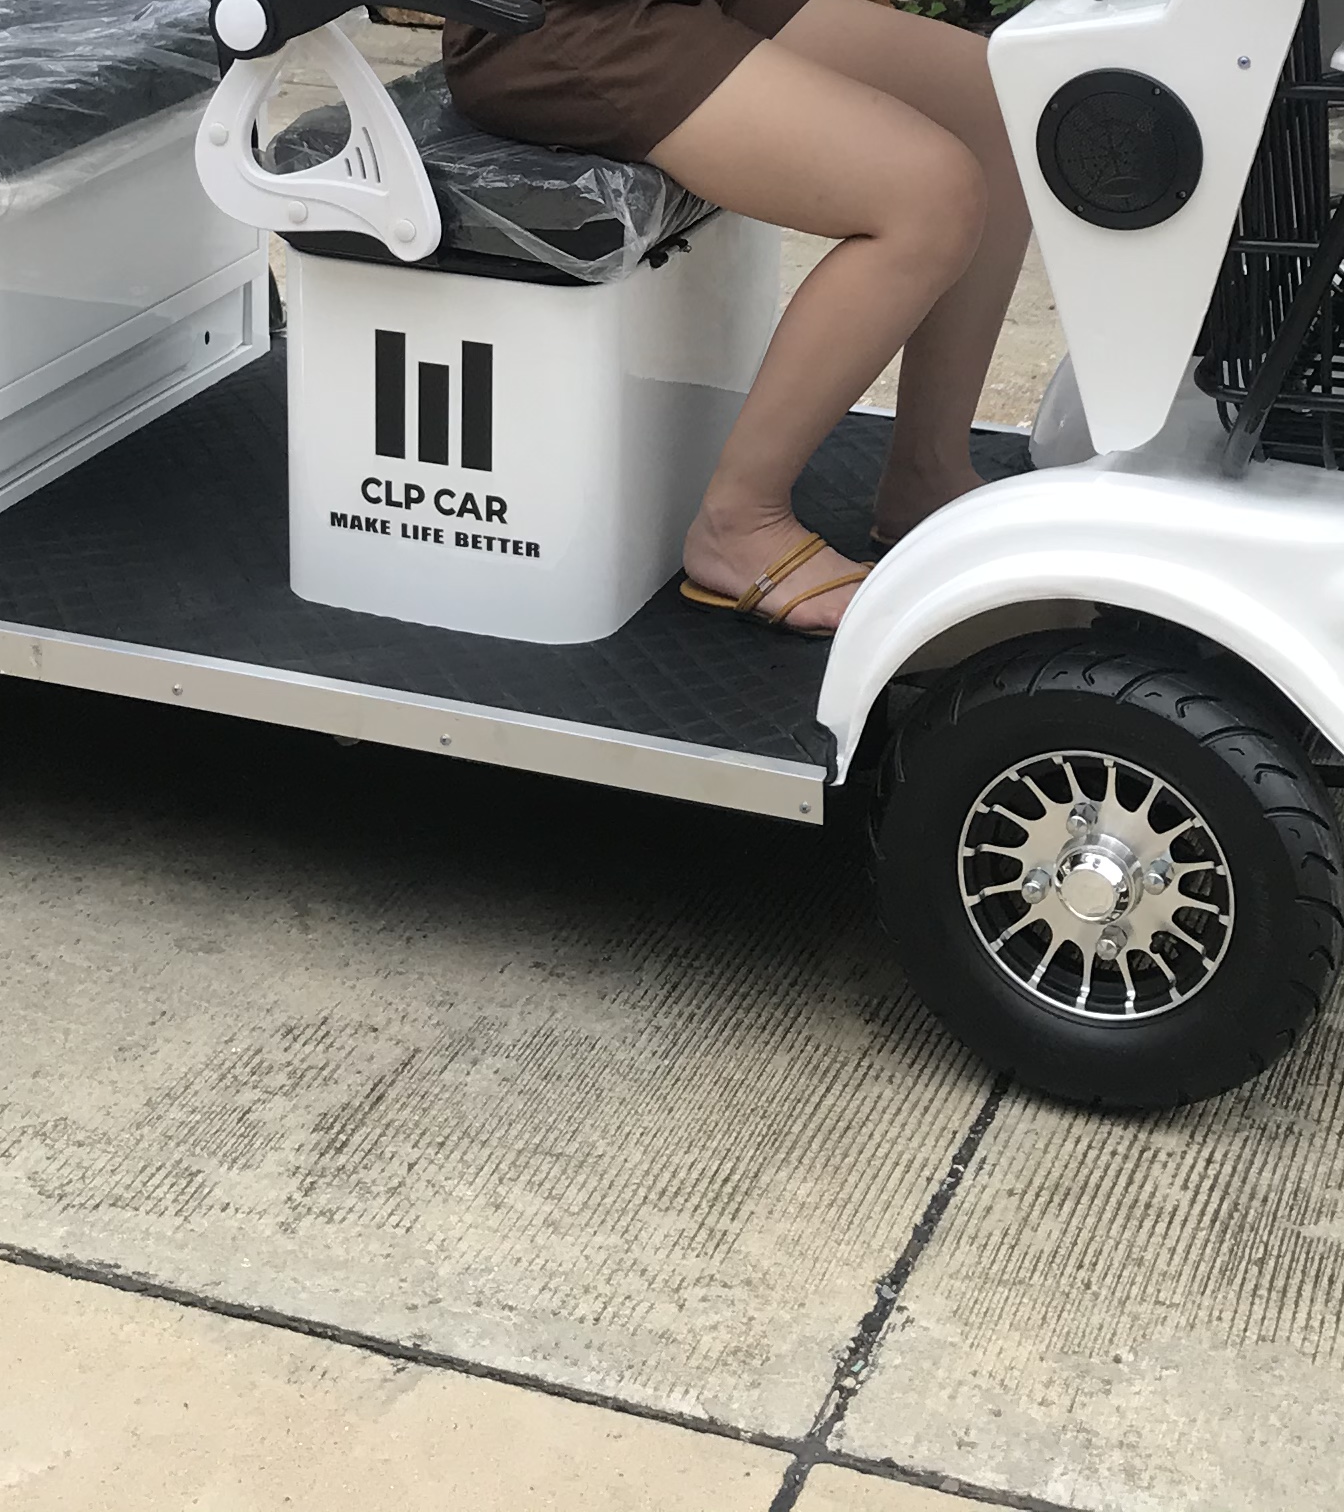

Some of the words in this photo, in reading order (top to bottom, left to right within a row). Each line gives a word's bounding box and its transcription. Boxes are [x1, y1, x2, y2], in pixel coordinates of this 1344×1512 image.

[360, 476, 426, 511] CLP
[433, 488, 508, 525] CAR
[329, 511, 392, 536] MAKE
[401, 522, 445, 545] LIFE
[454, 531, 541, 559] BETTER
